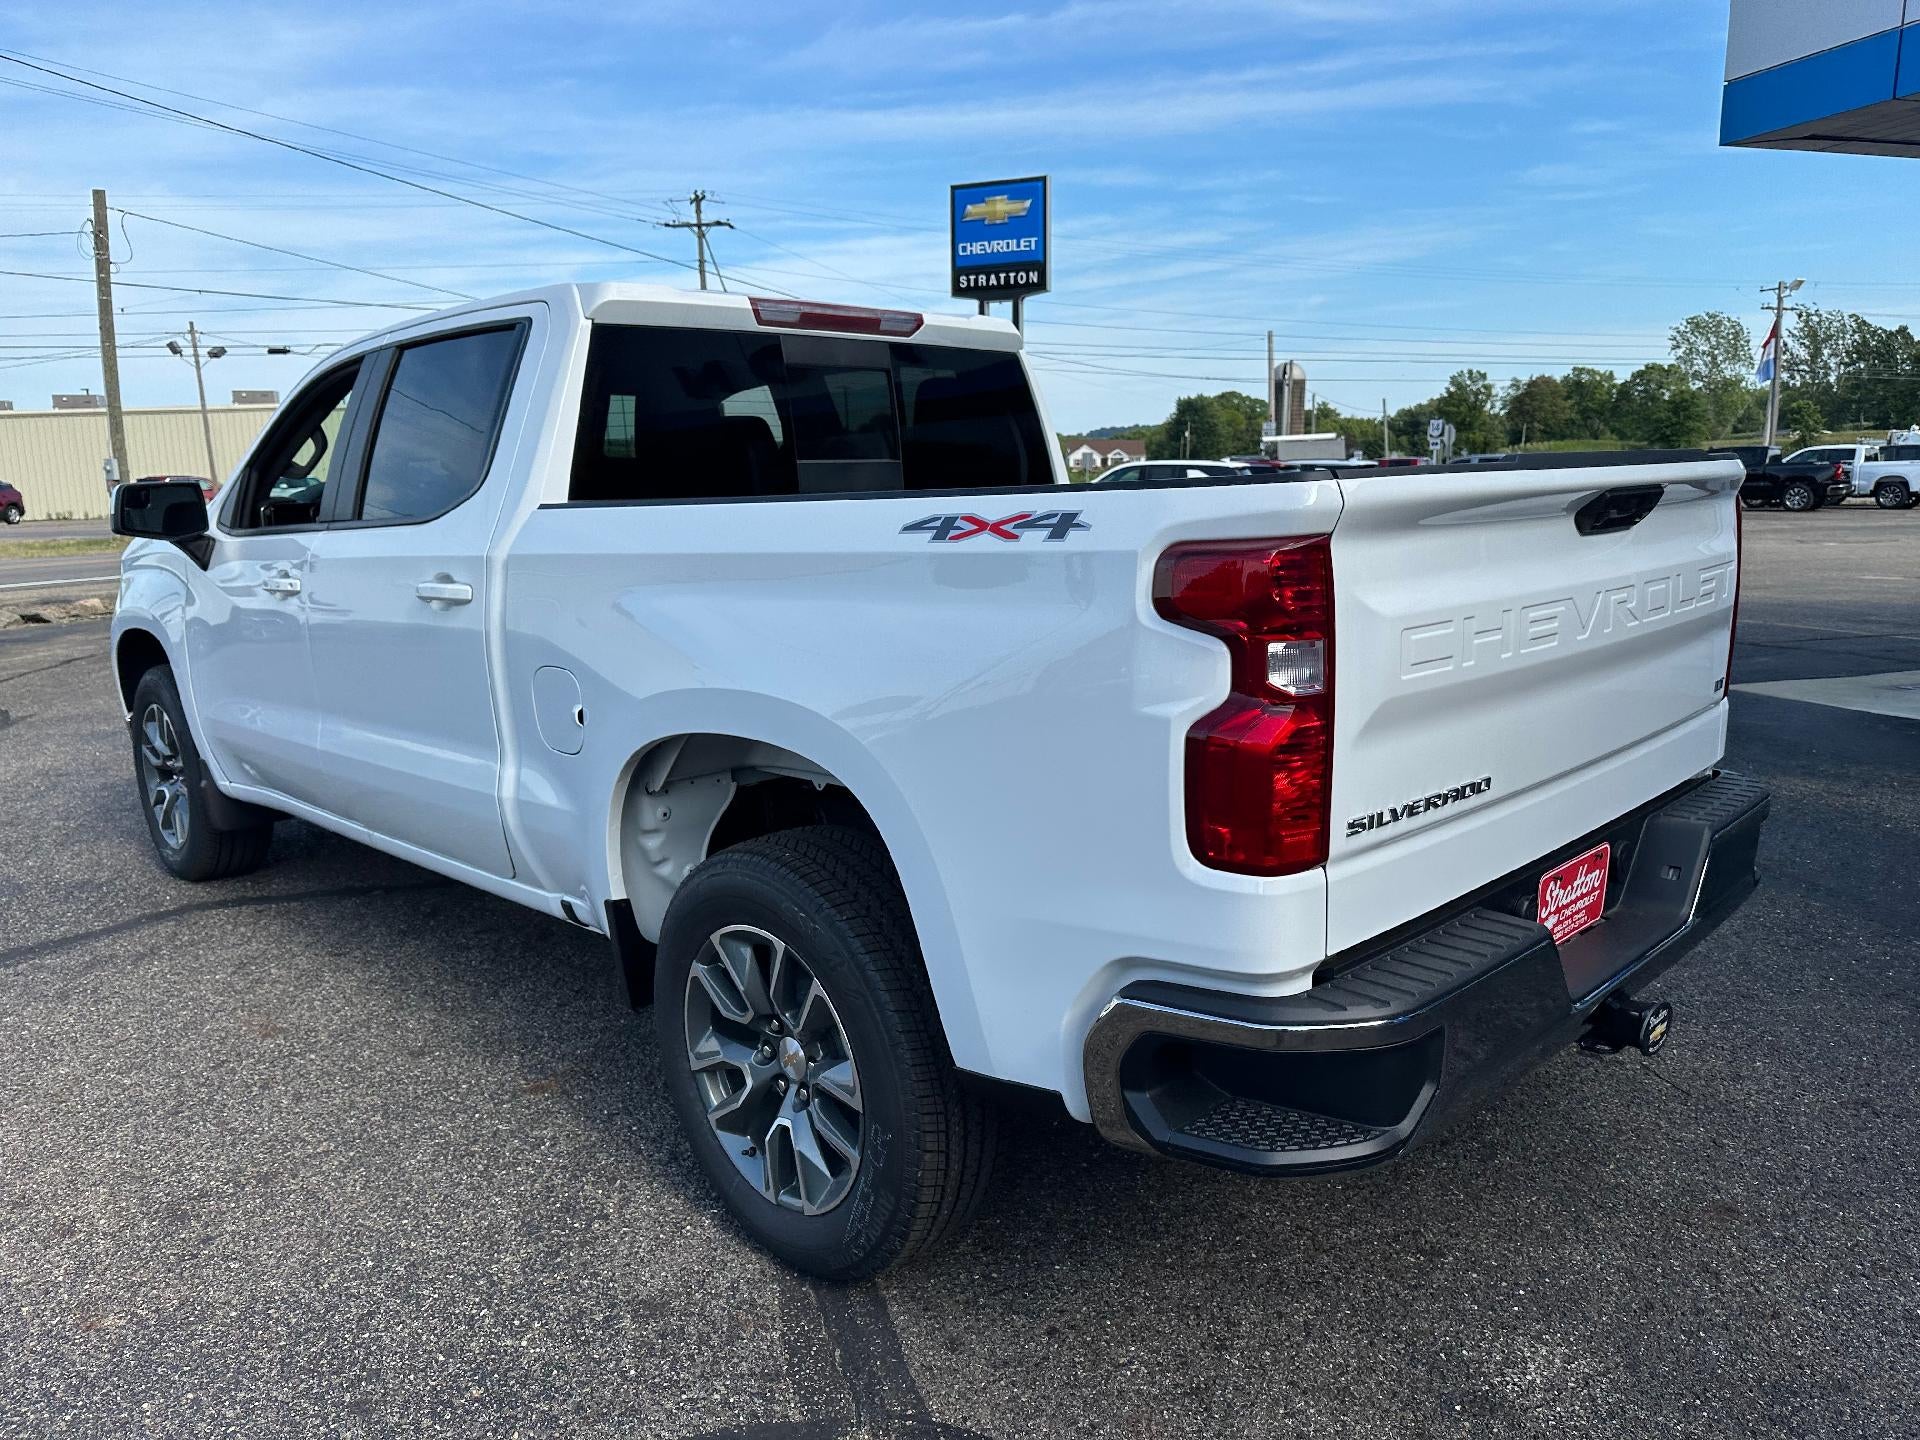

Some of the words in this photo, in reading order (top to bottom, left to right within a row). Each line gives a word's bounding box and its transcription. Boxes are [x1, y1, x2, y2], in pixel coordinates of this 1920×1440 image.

[958, 237, 1038, 255] CHEVROLET
[959, 271, 1038, 288] STRATTON
[1400, 560, 1736, 680] CHEVROLET
[1346, 776, 1492, 838] SILVERADO
[1541, 864, 1604, 918] Stratton
[1560, 890, 1600, 920] CHEVROLET
